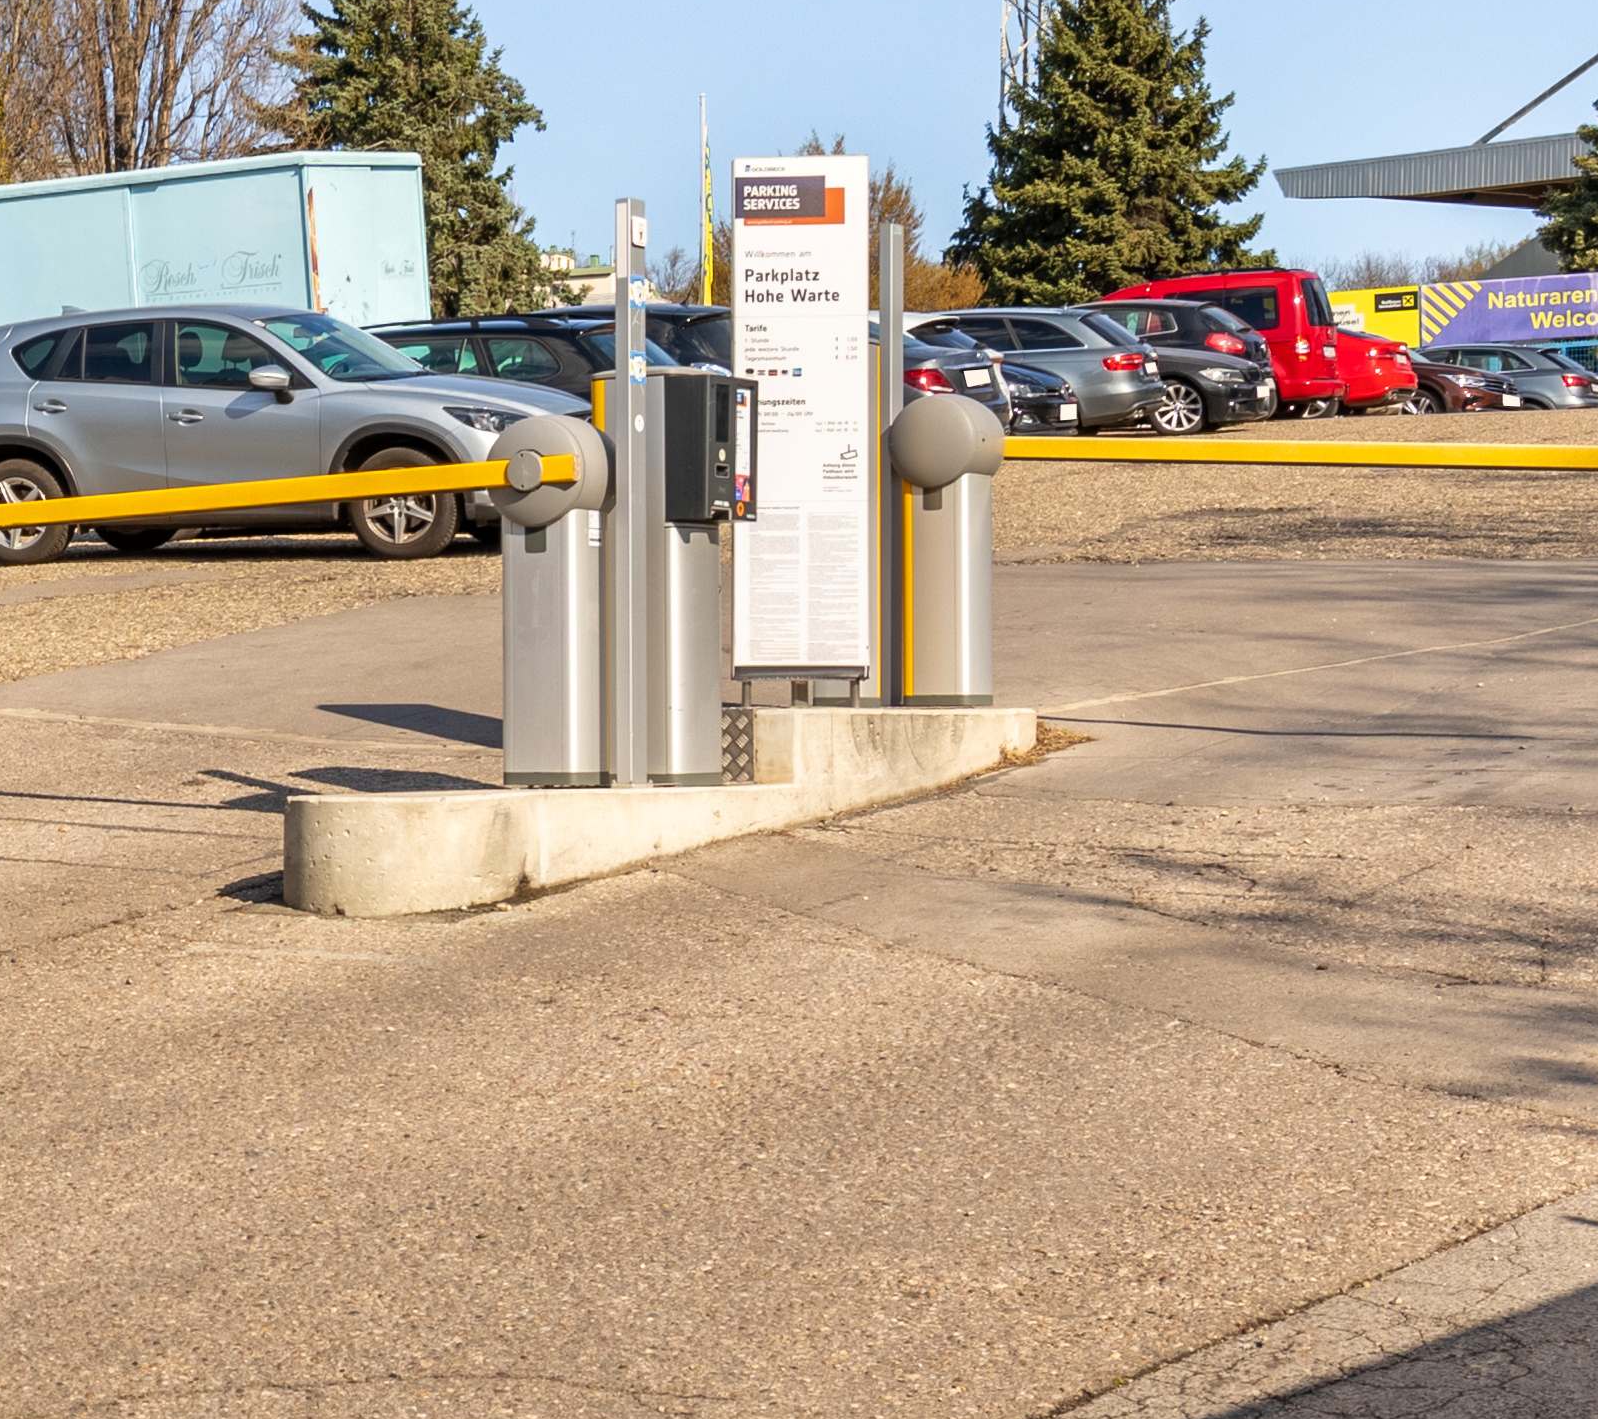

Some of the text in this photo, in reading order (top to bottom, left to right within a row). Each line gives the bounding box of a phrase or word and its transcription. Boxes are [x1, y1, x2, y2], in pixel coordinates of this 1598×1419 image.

[743, 184, 798, 197] PARKING
[743, 198, 801, 210] SERVICES
[745, 251, 796, 259] Willkommen
[745, 268, 820, 284] Parkplatz
[745, 288, 840, 303] Hohe Warte
[745, 324, 767, 332] Tarife
